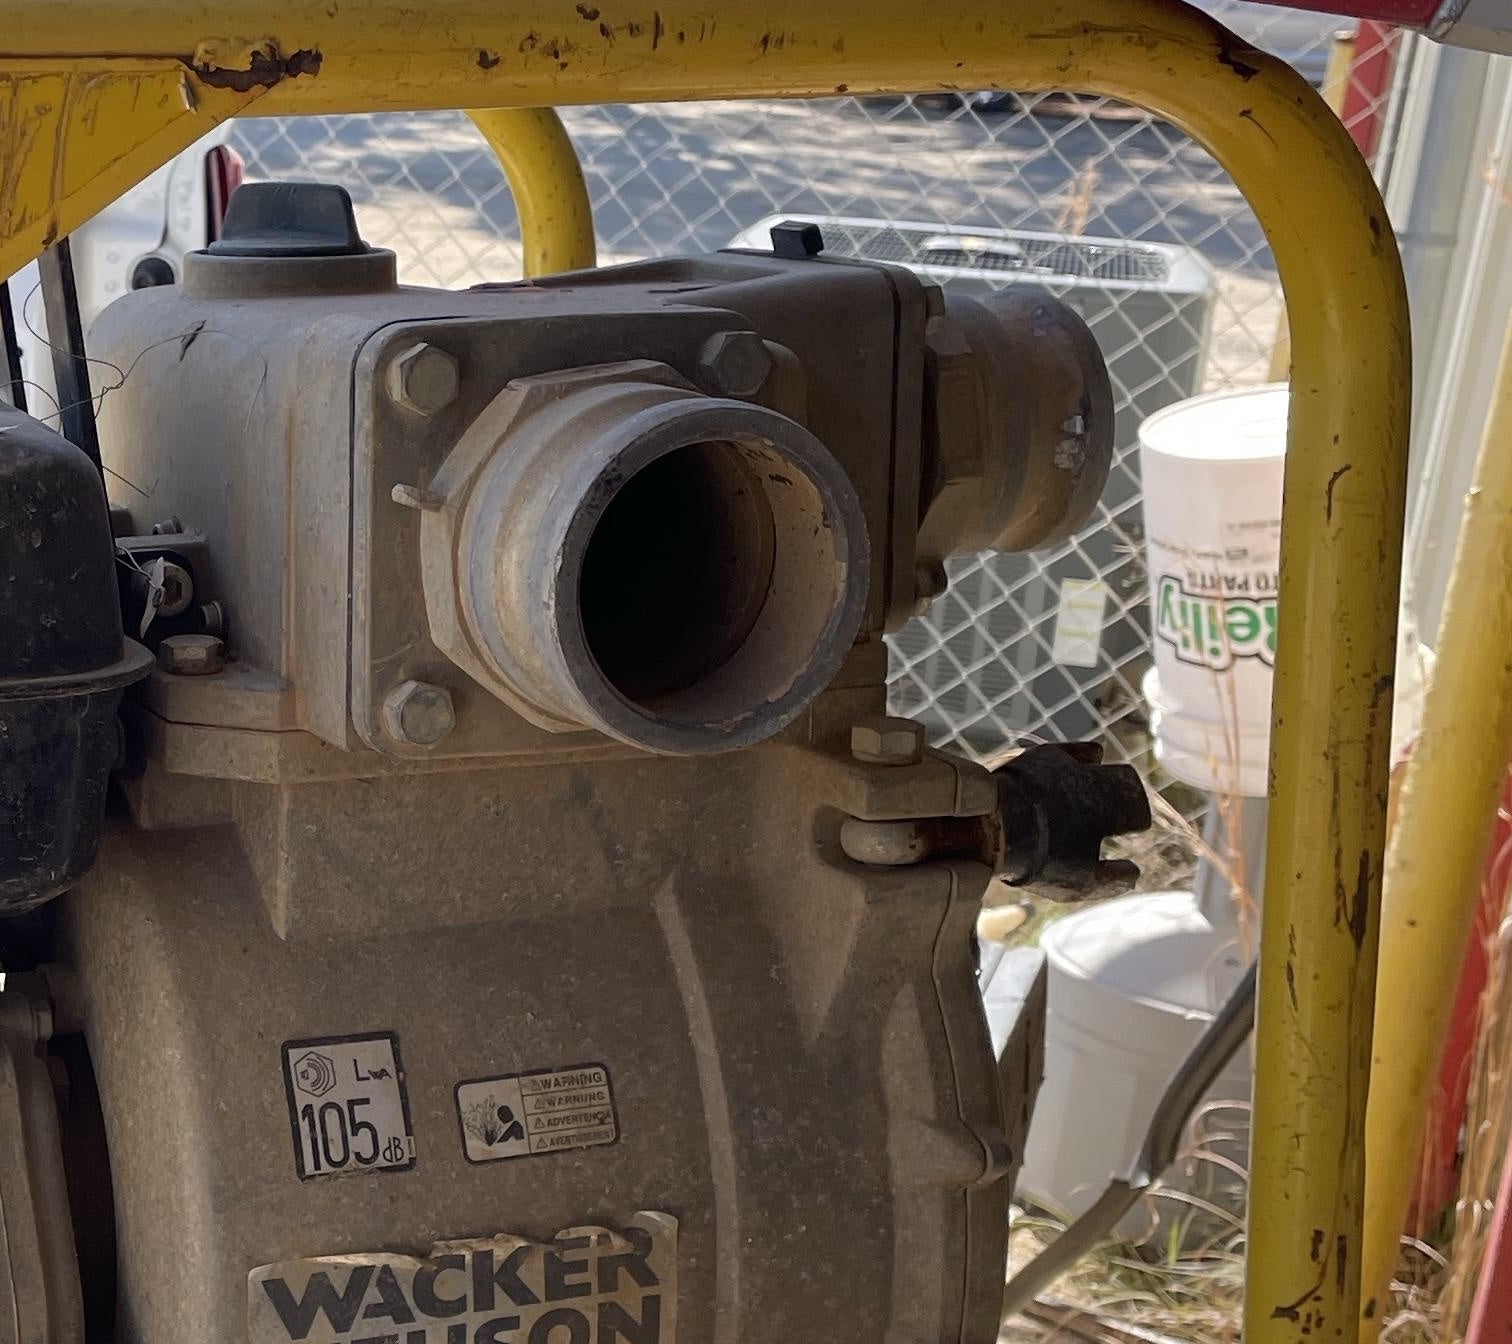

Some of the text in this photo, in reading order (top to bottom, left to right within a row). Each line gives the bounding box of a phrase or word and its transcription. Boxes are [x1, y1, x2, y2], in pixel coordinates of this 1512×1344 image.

[539, 1071, 603, 1090] WARNING
[546, 1090, 606, 1107] WARNING
[301, 1097, 405, 1172] 105 dB
[261, 1227, 660, 1340] WACKER
